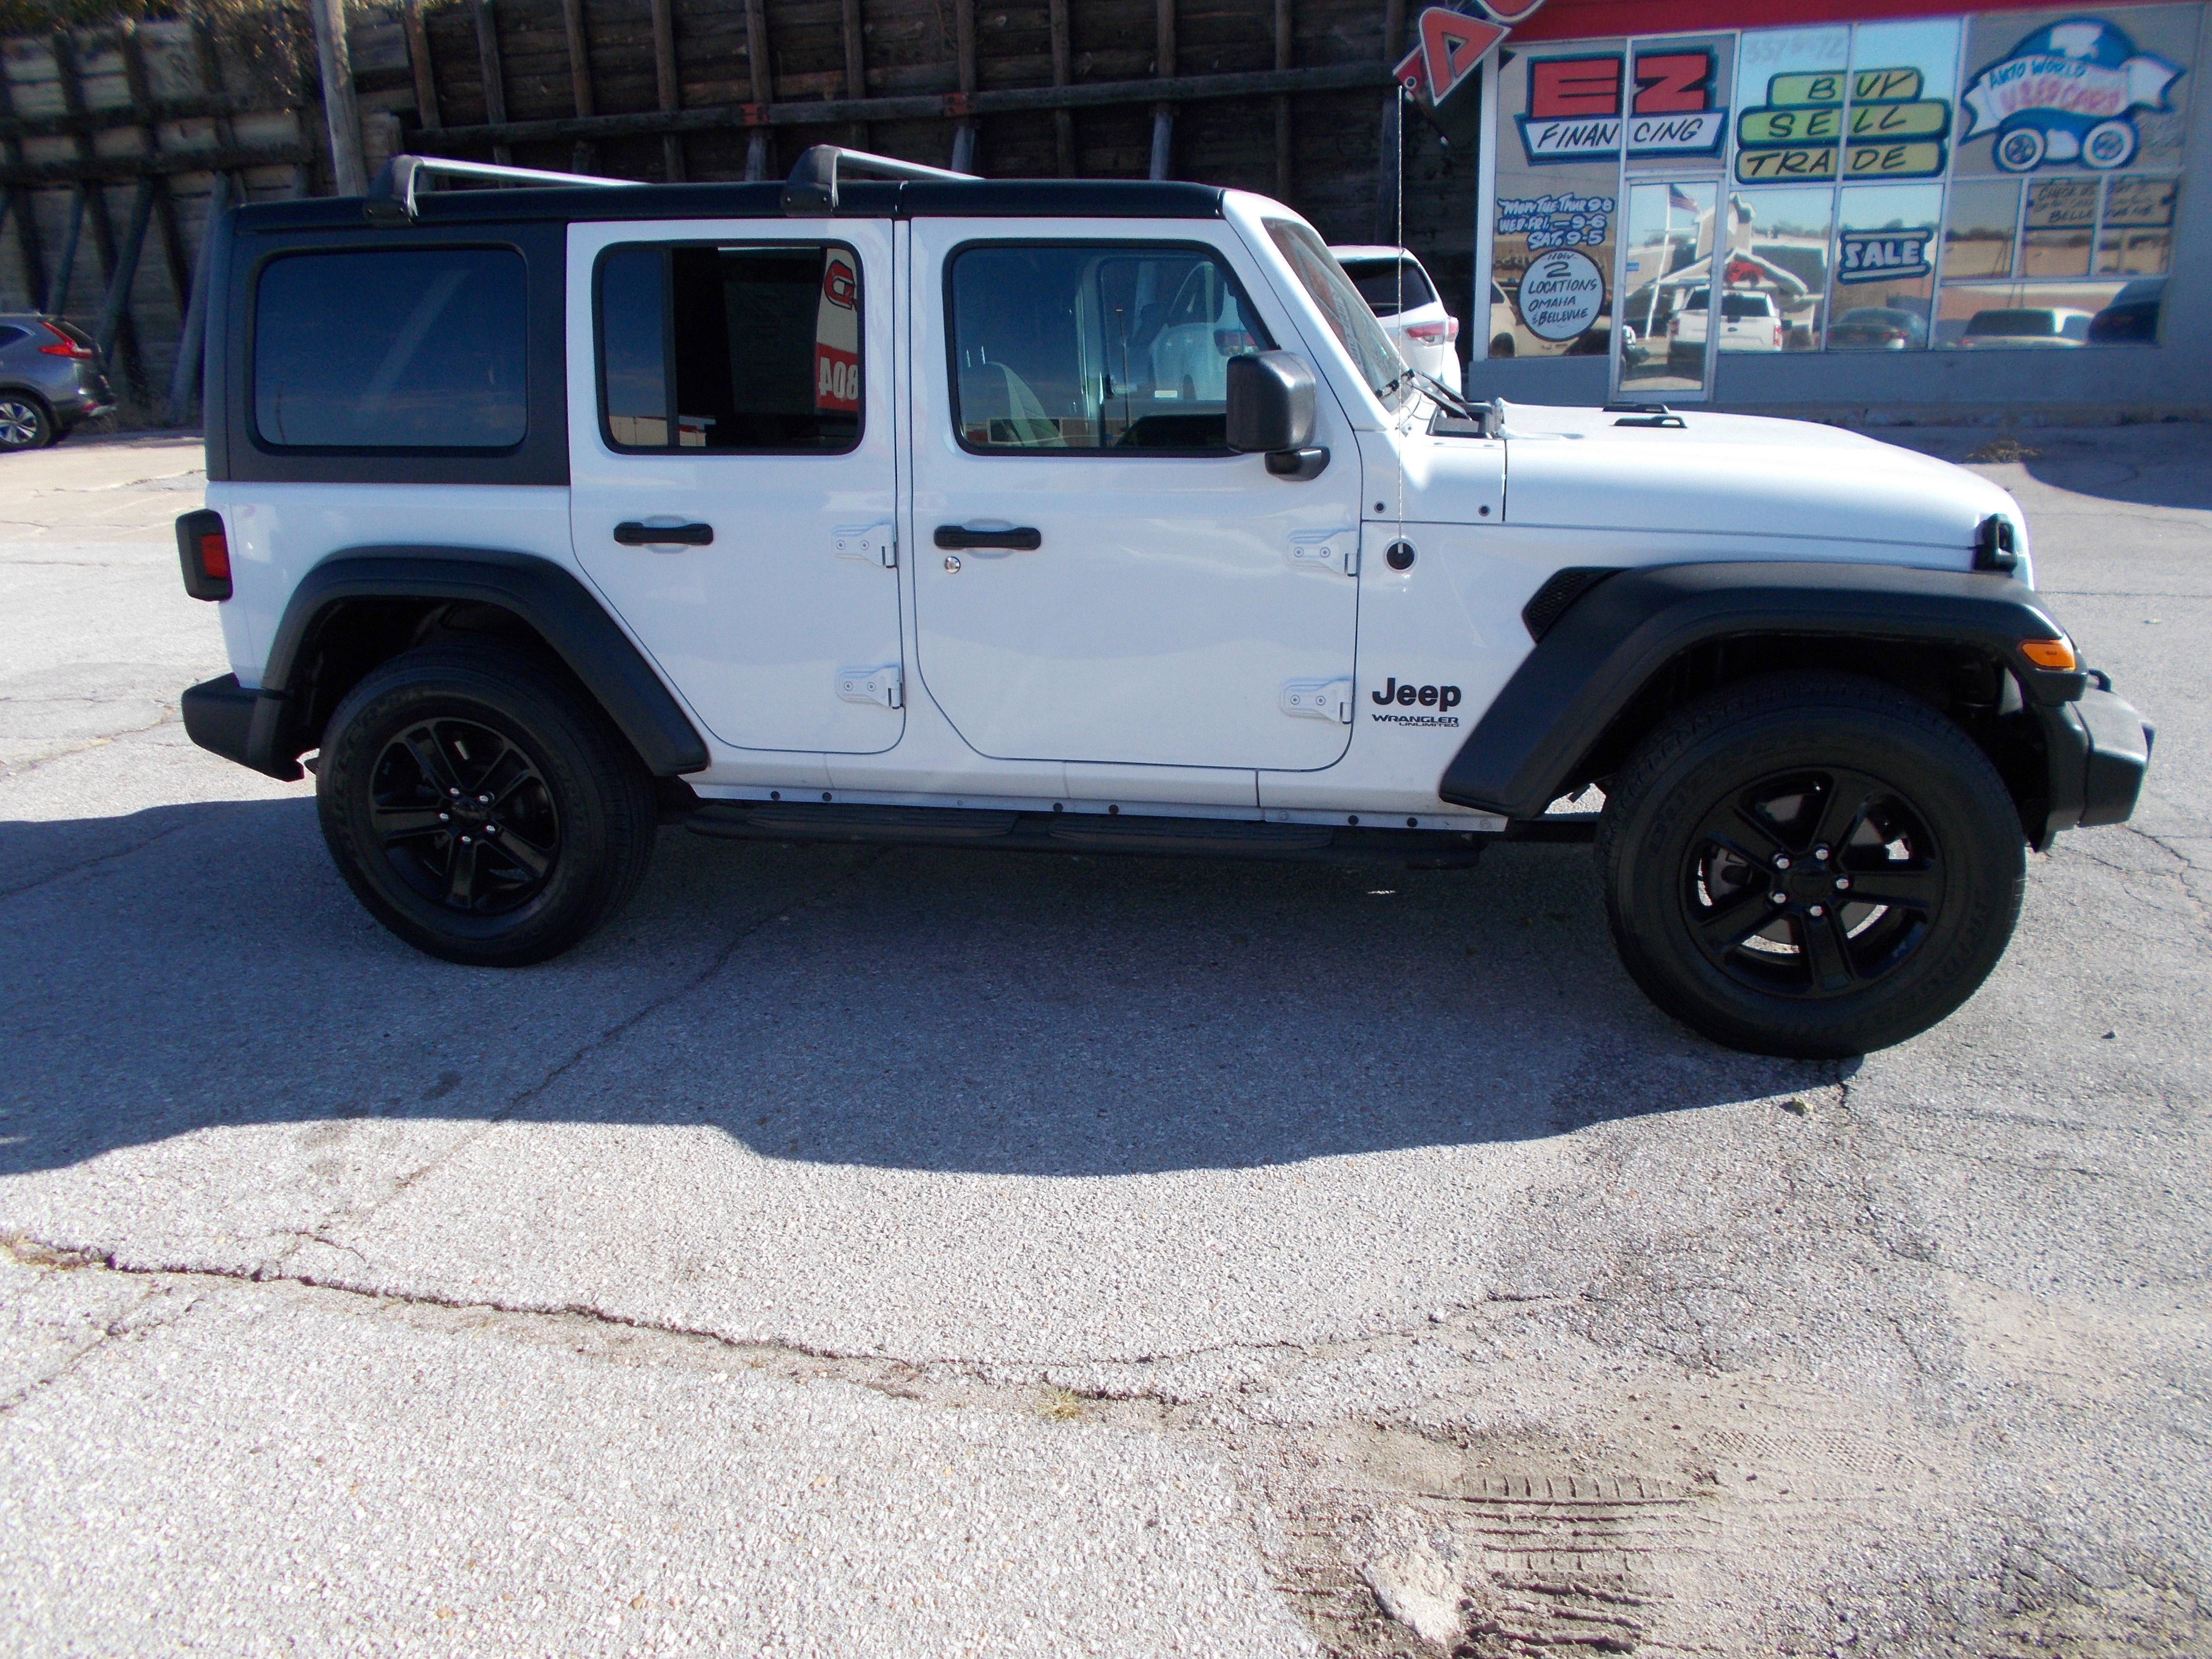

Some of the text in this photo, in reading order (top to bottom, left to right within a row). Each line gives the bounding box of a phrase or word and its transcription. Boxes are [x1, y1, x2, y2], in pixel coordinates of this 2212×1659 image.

[1530, 52, 1709, 118] EZ
[1807, 71, 1915, 100] BUY
[1537, 117, 1704, 149] FINANCING
[1768, 105, 1907, 138] SELL
[1746, 145, 1907, 176] TRADE
[1566, 230, 1603, 246] 9-5
[1845, 240, 1920, 268] SALE
[1544, 261, 1571, 277] 2
[1528, 278, 1597, 294] LOCATIONS
[1528, 296, 1576, 312] OMAHA
[1372, 677, 1461, 712] Jeep
[1371, 714, 1458, 723] WRANGLER
